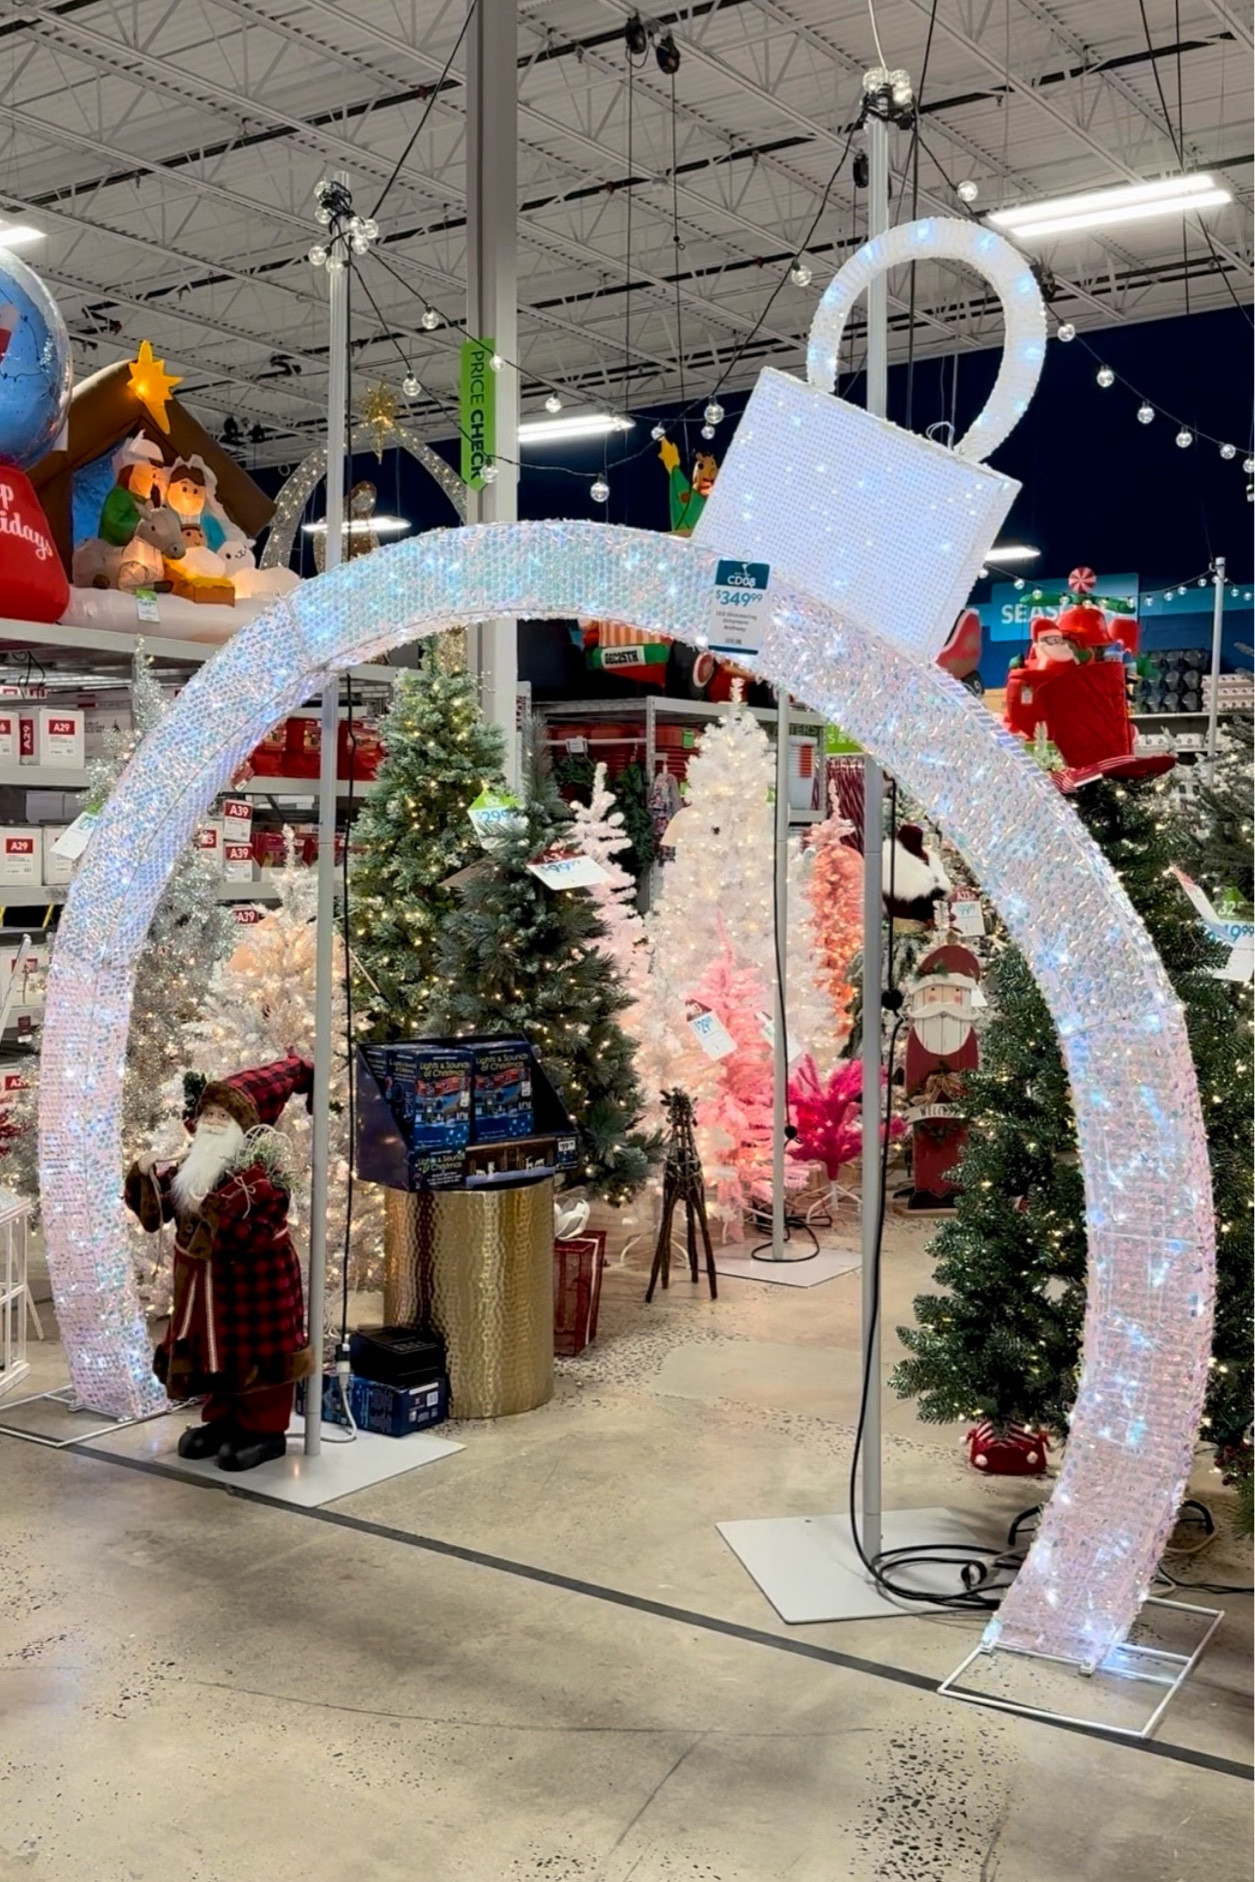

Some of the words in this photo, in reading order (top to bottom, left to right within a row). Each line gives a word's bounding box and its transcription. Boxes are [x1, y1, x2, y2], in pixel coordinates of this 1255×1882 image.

[470, 350, 484, 405] PRICE
[470, 409, 484, 480] CHECK
[53, 723, 71, 732] A29
[23, 725, 32, 749] A29
[229, 804, 249, 817] A39
[10, 841, 29, 851] A29
[229, 848, 249, 859] A39
[237, 911, 255, 922] A39
